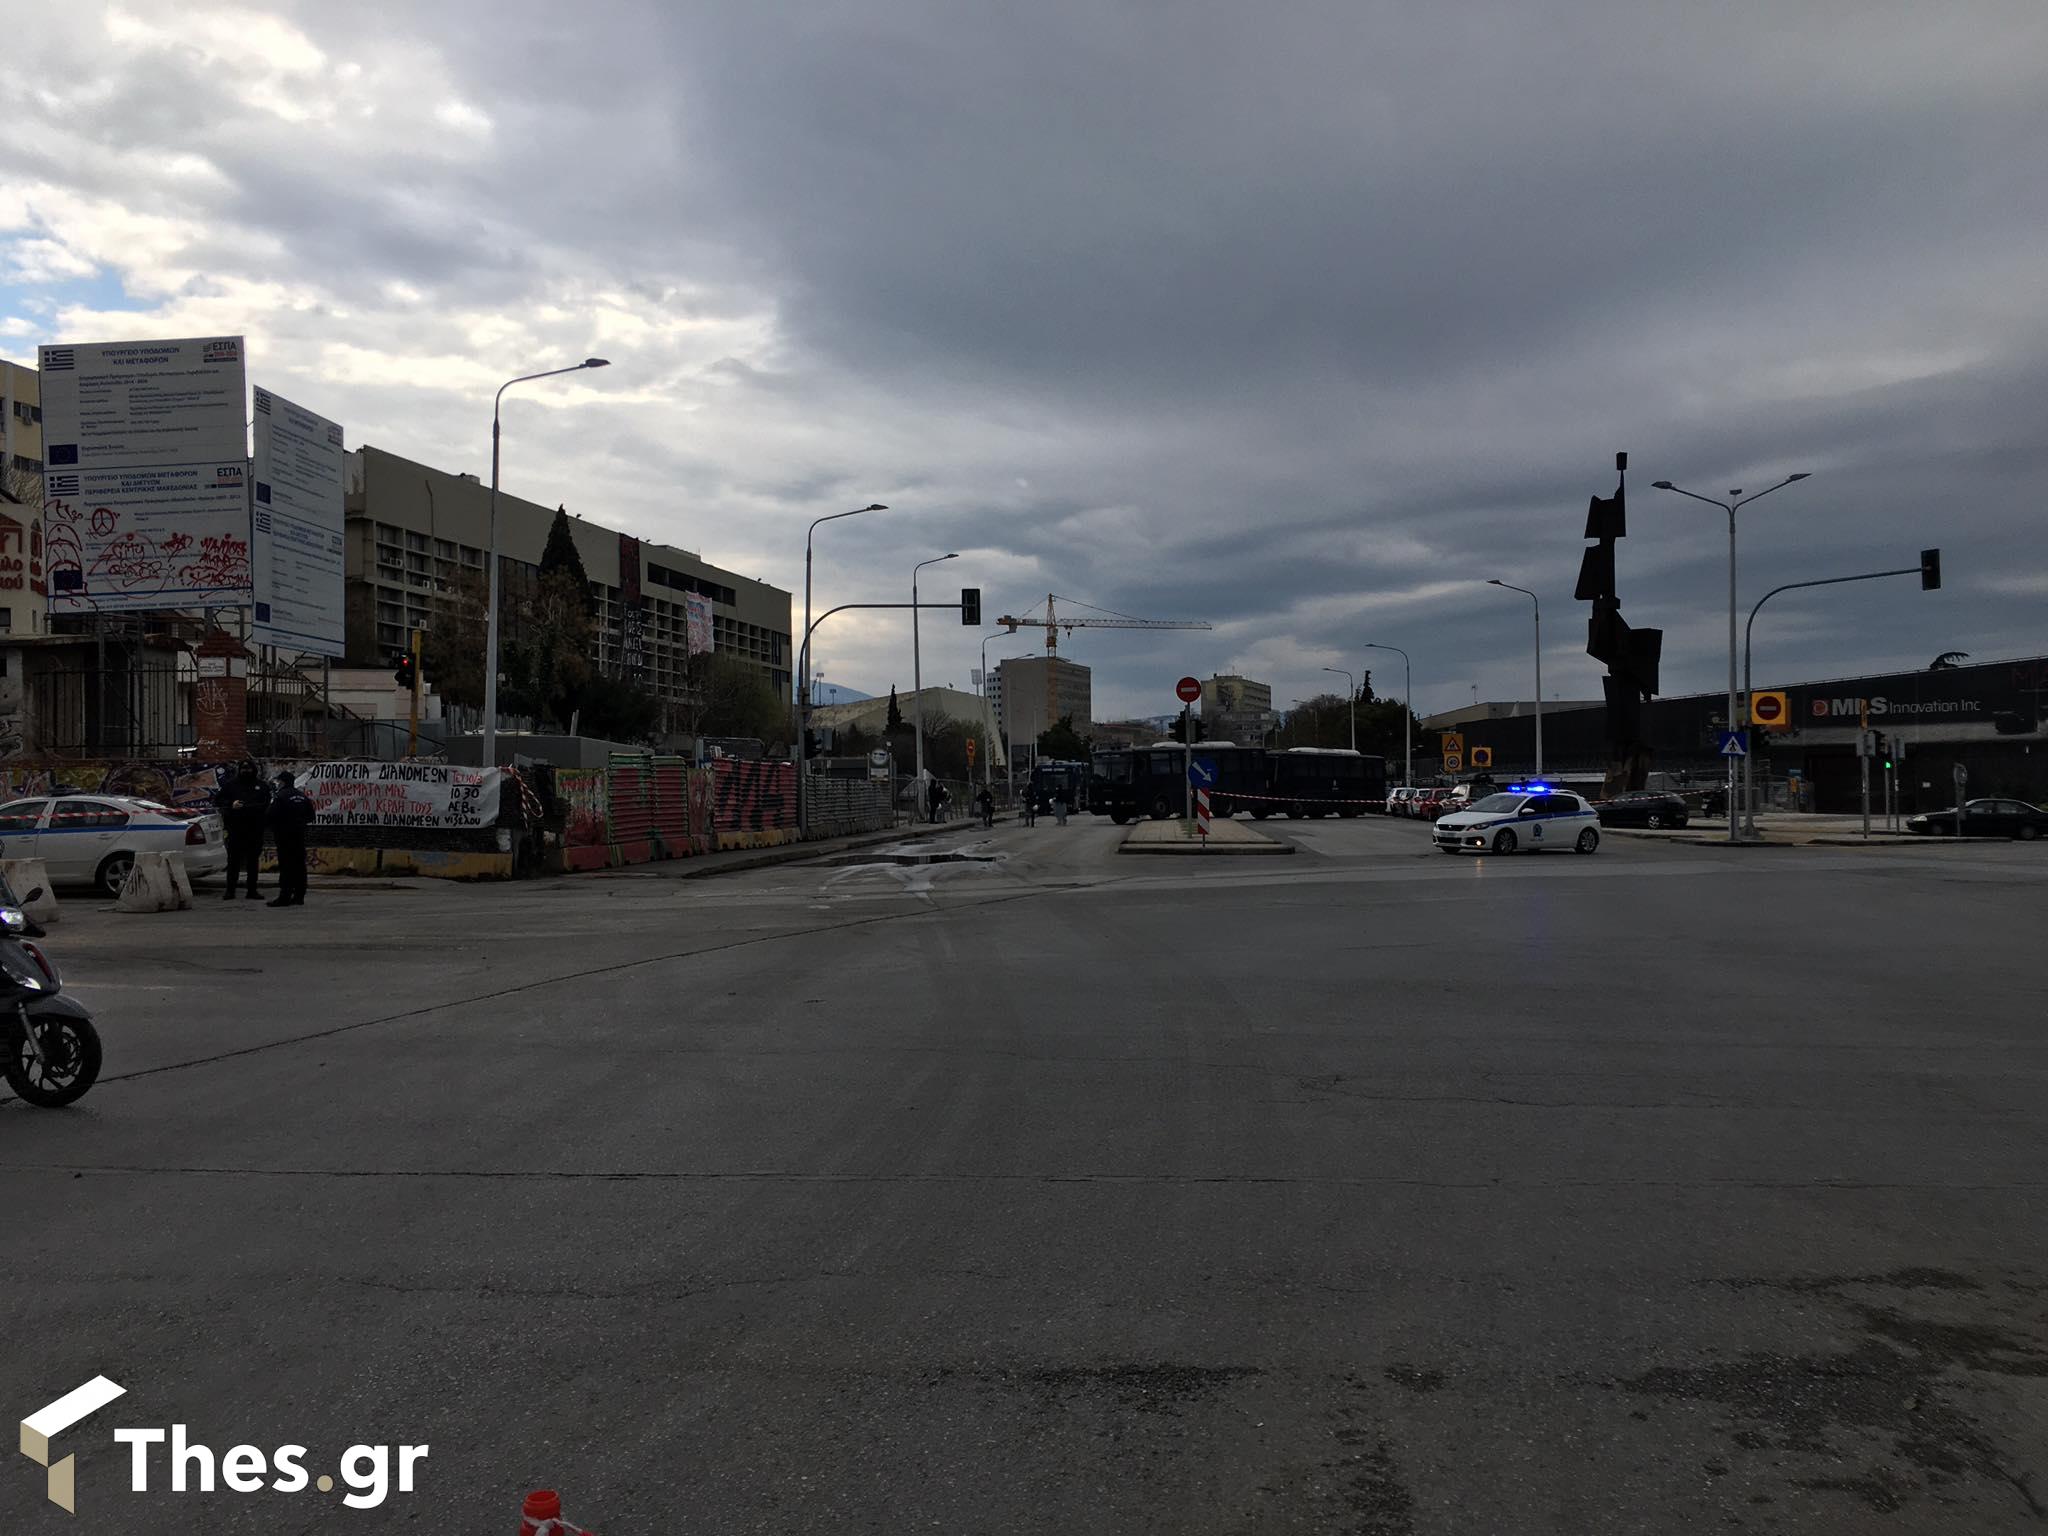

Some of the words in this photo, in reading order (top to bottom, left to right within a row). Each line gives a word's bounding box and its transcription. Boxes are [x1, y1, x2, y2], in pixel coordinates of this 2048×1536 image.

[212, 341, 237, 352] ΕΣΠΑ
[216, 467, 242, 477] ΕΣΠΑ
[1831, 696, 1888, 716] MLS
[1889, 698, 1959, 715] Innovation
[1960, 698, 1982, 712] Inc
[308, 763, 370, 780] ΟΤΟΠΟΡΕΙΑ
[379, 763, 448, 784] ΔΙΑΝΟΜΕΩΝ
[376, 799, 405, 814] ΚΕΡΔΗ
[382, 812, 440, 827] ΔΙΑΝΟΜΕΩΝ
